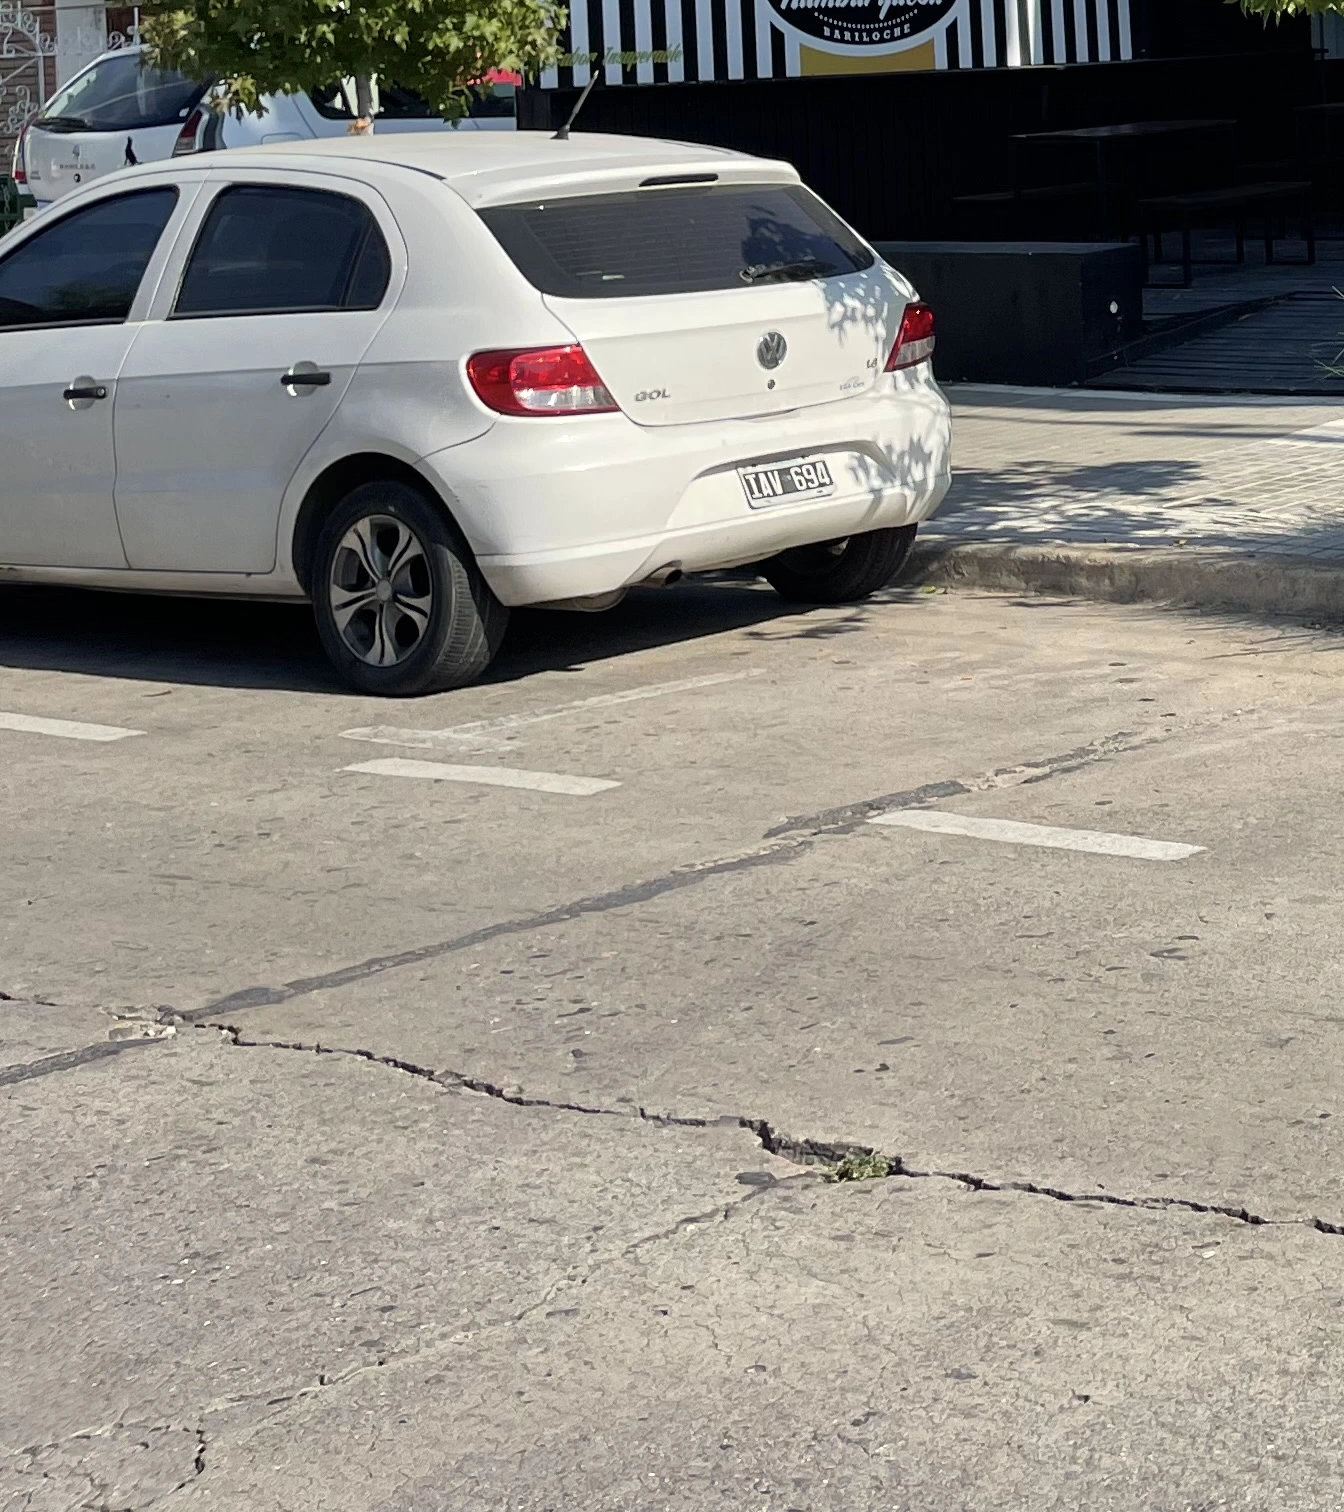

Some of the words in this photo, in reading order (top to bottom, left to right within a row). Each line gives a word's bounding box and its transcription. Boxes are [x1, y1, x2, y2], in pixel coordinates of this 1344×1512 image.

[823, 23, 911, 42] BARILOCHE
[634, 388, 671, 402] GOL
[744, 469, 784, 499] IAV
[789, 461, 831, 491] 694
